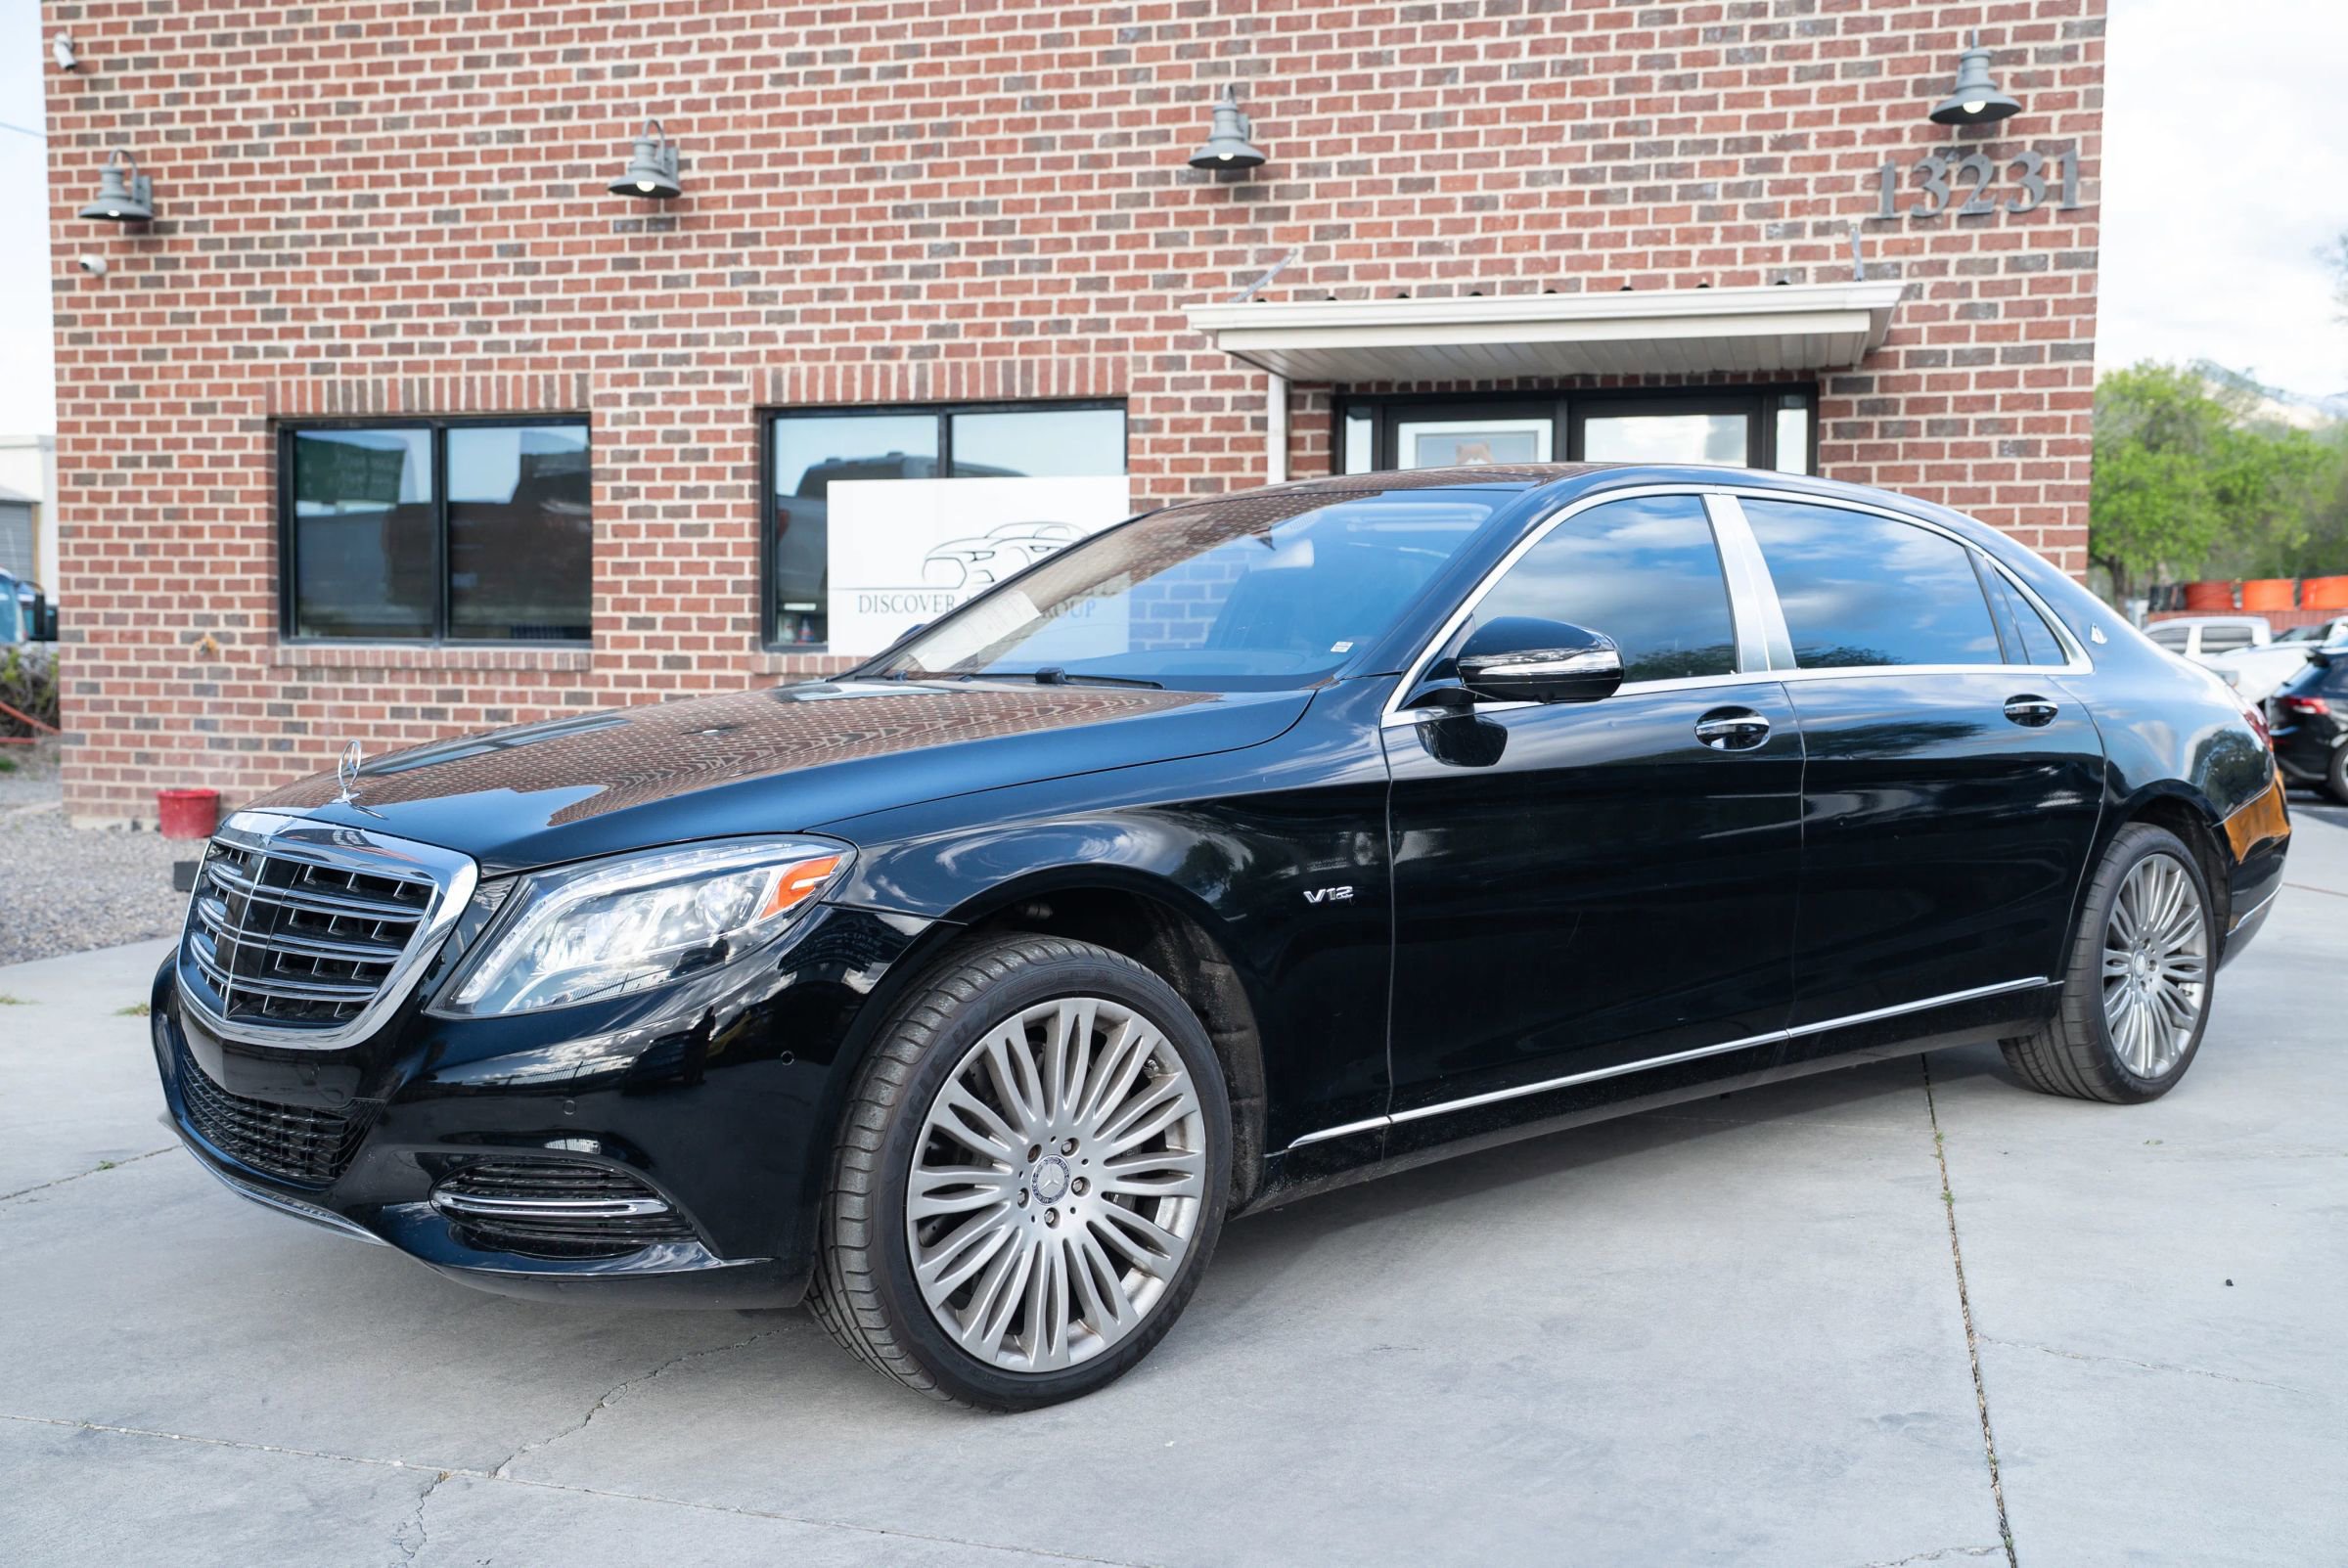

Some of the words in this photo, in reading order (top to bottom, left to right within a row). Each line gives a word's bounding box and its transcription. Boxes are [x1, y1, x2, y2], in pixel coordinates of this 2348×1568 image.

[1873, 149, 2086, 219] 13231
[859, 594, 955, 613] DISCOVER
[1303, 885, 1354, 903] V12
